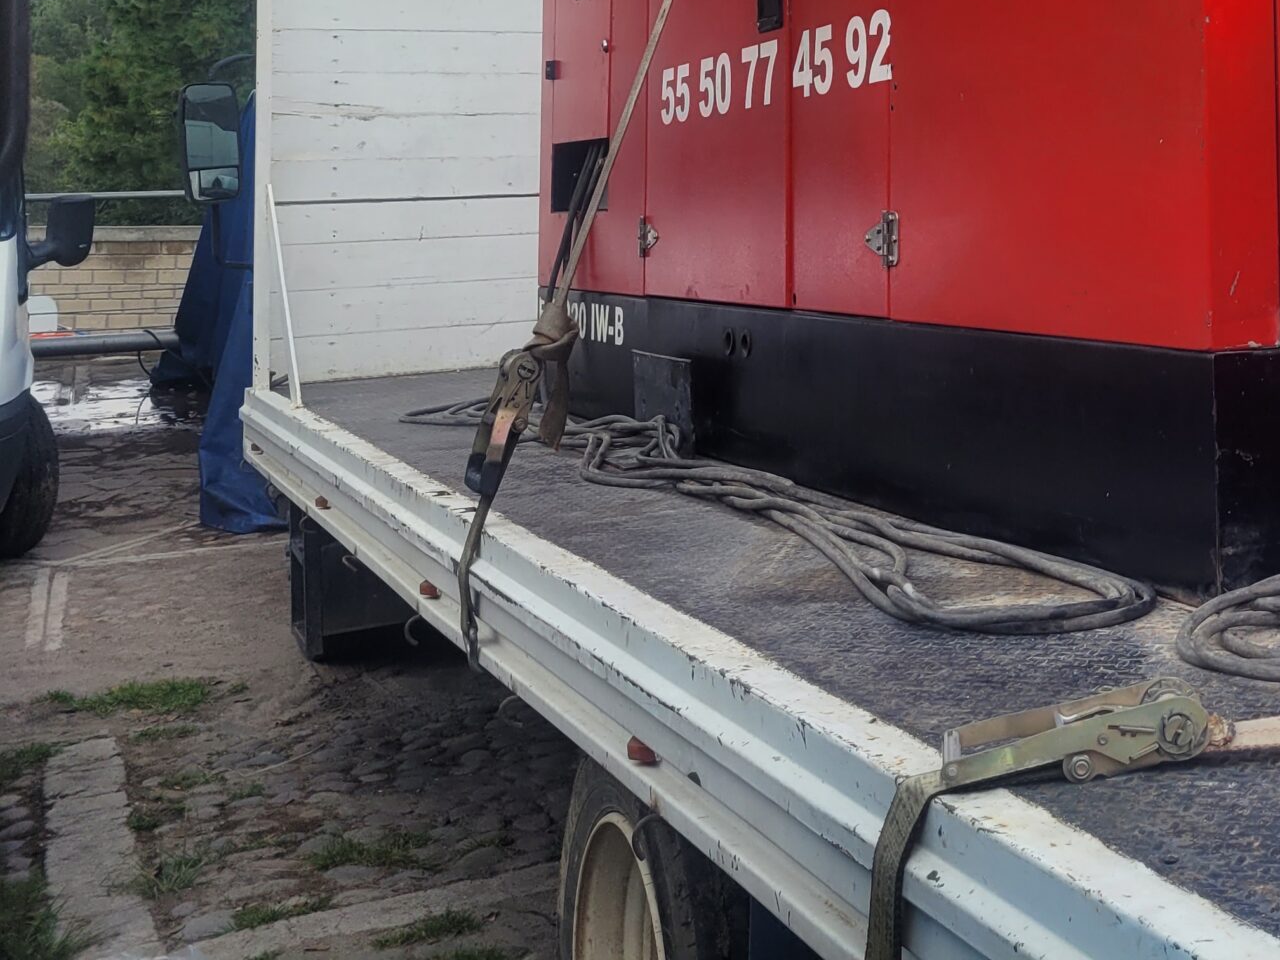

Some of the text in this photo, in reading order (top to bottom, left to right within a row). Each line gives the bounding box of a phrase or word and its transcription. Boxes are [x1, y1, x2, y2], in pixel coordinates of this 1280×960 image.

[660, 8, 893, 125] 55 50 77 45 92
[590, 303, 624, 346] IW-B
